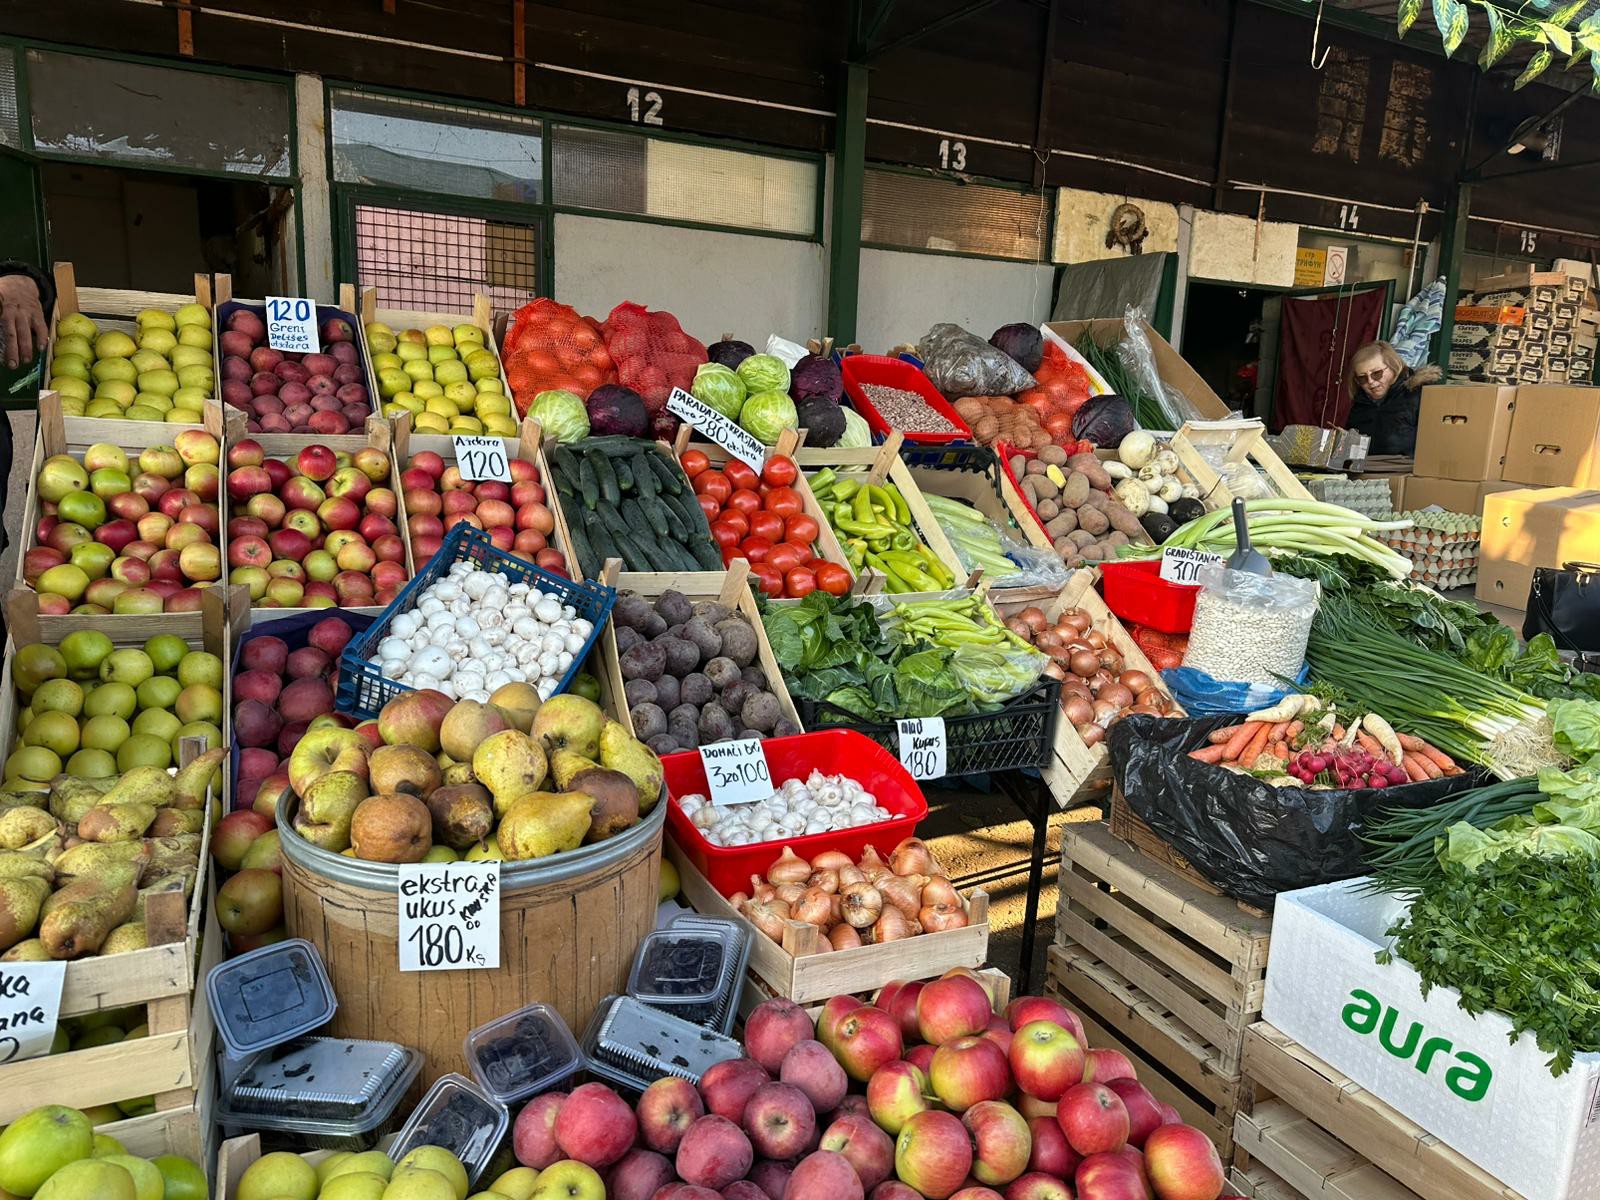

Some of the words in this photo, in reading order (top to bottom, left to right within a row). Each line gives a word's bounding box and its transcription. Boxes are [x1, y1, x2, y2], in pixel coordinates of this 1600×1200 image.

[627, 87, 664, 126] 12
[939, 140, 966, 170] 13
[1340, 205, 1358, 228] 14
[1521, 231, 1536, 253] 15
[268, 299, 310, 321] 120
[692, 415, 728, 444] 280
[461, 450, 505, 478] 120
[904, 750, 937, 778] 180
[400, 870, 478, 896] ekstra
[406, 897, 456, 920] ukus
[408, 923, 464, 967] 180
[1341, 988, 1493, 1102] aura
